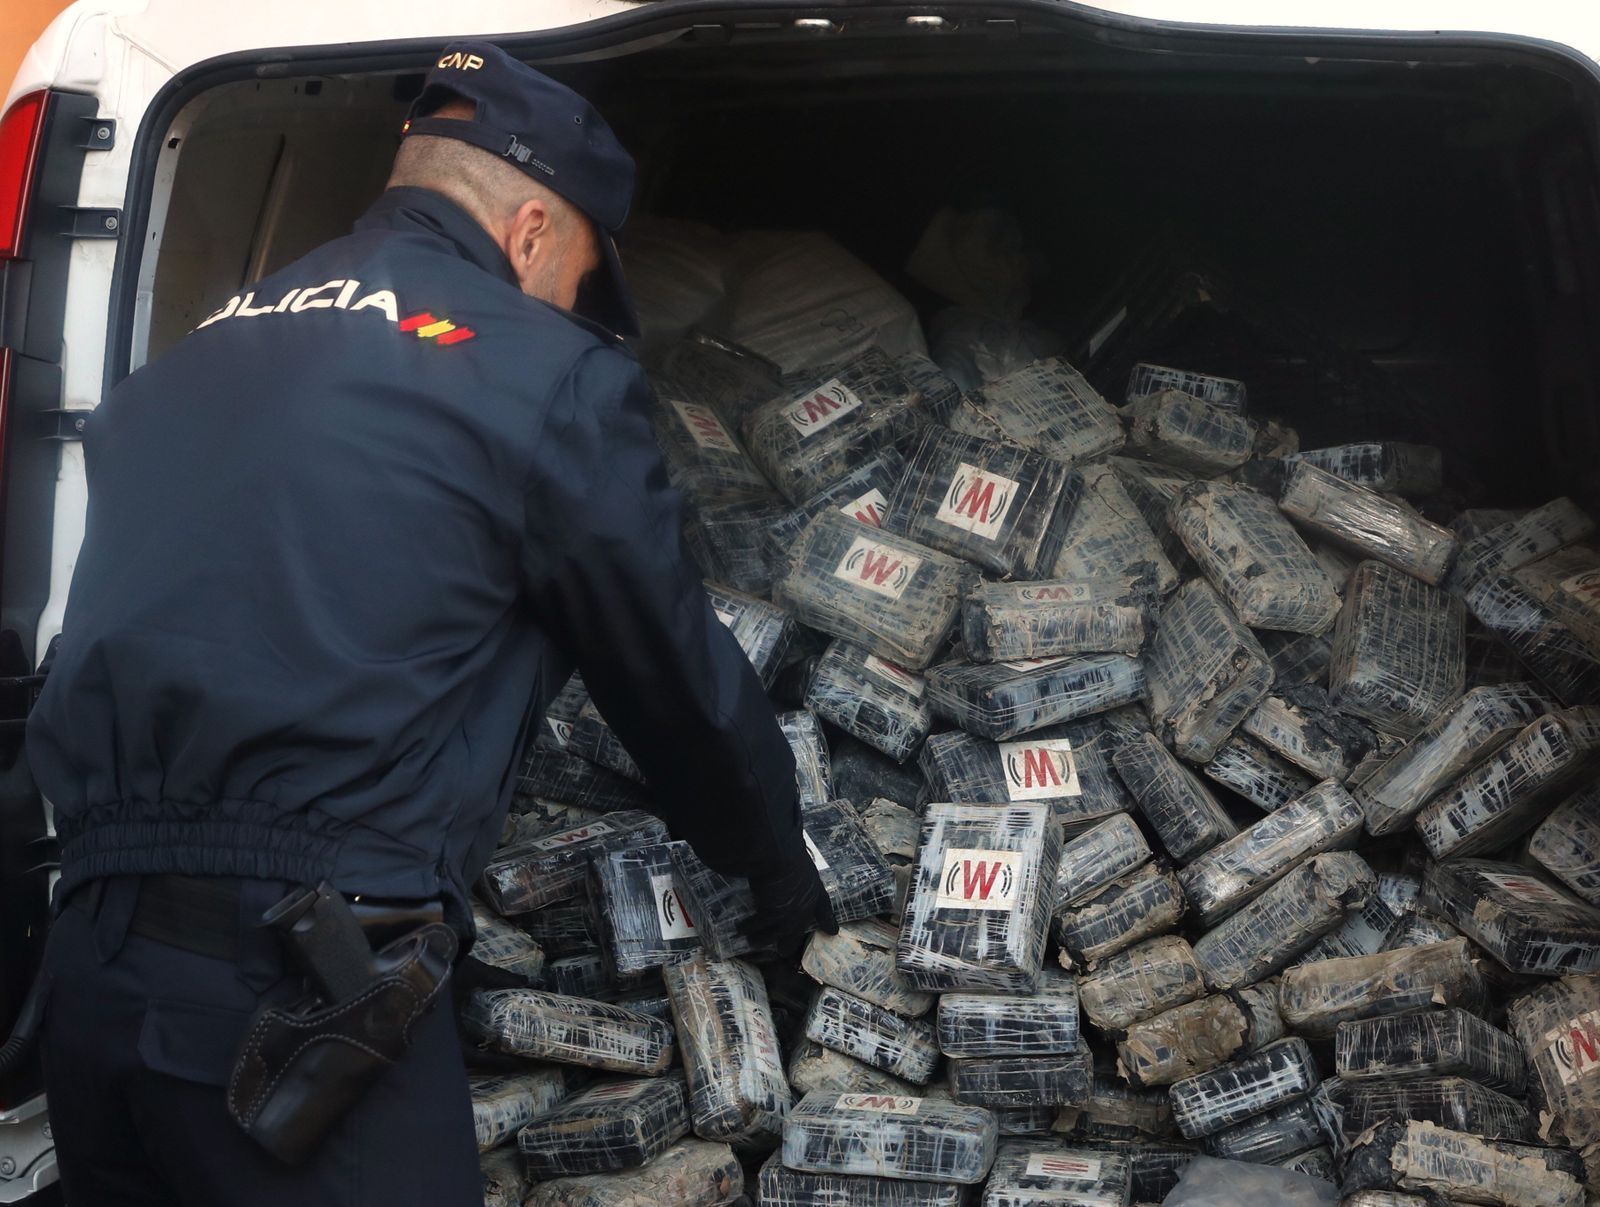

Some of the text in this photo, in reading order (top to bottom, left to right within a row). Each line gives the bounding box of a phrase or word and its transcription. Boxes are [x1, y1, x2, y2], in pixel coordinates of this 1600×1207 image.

[437, 52, 484, 71] CNP
[188, 279, 399, 333] OLICIA
[859, 549, 903, 587] W
[963, 860, 1001, 901] W
